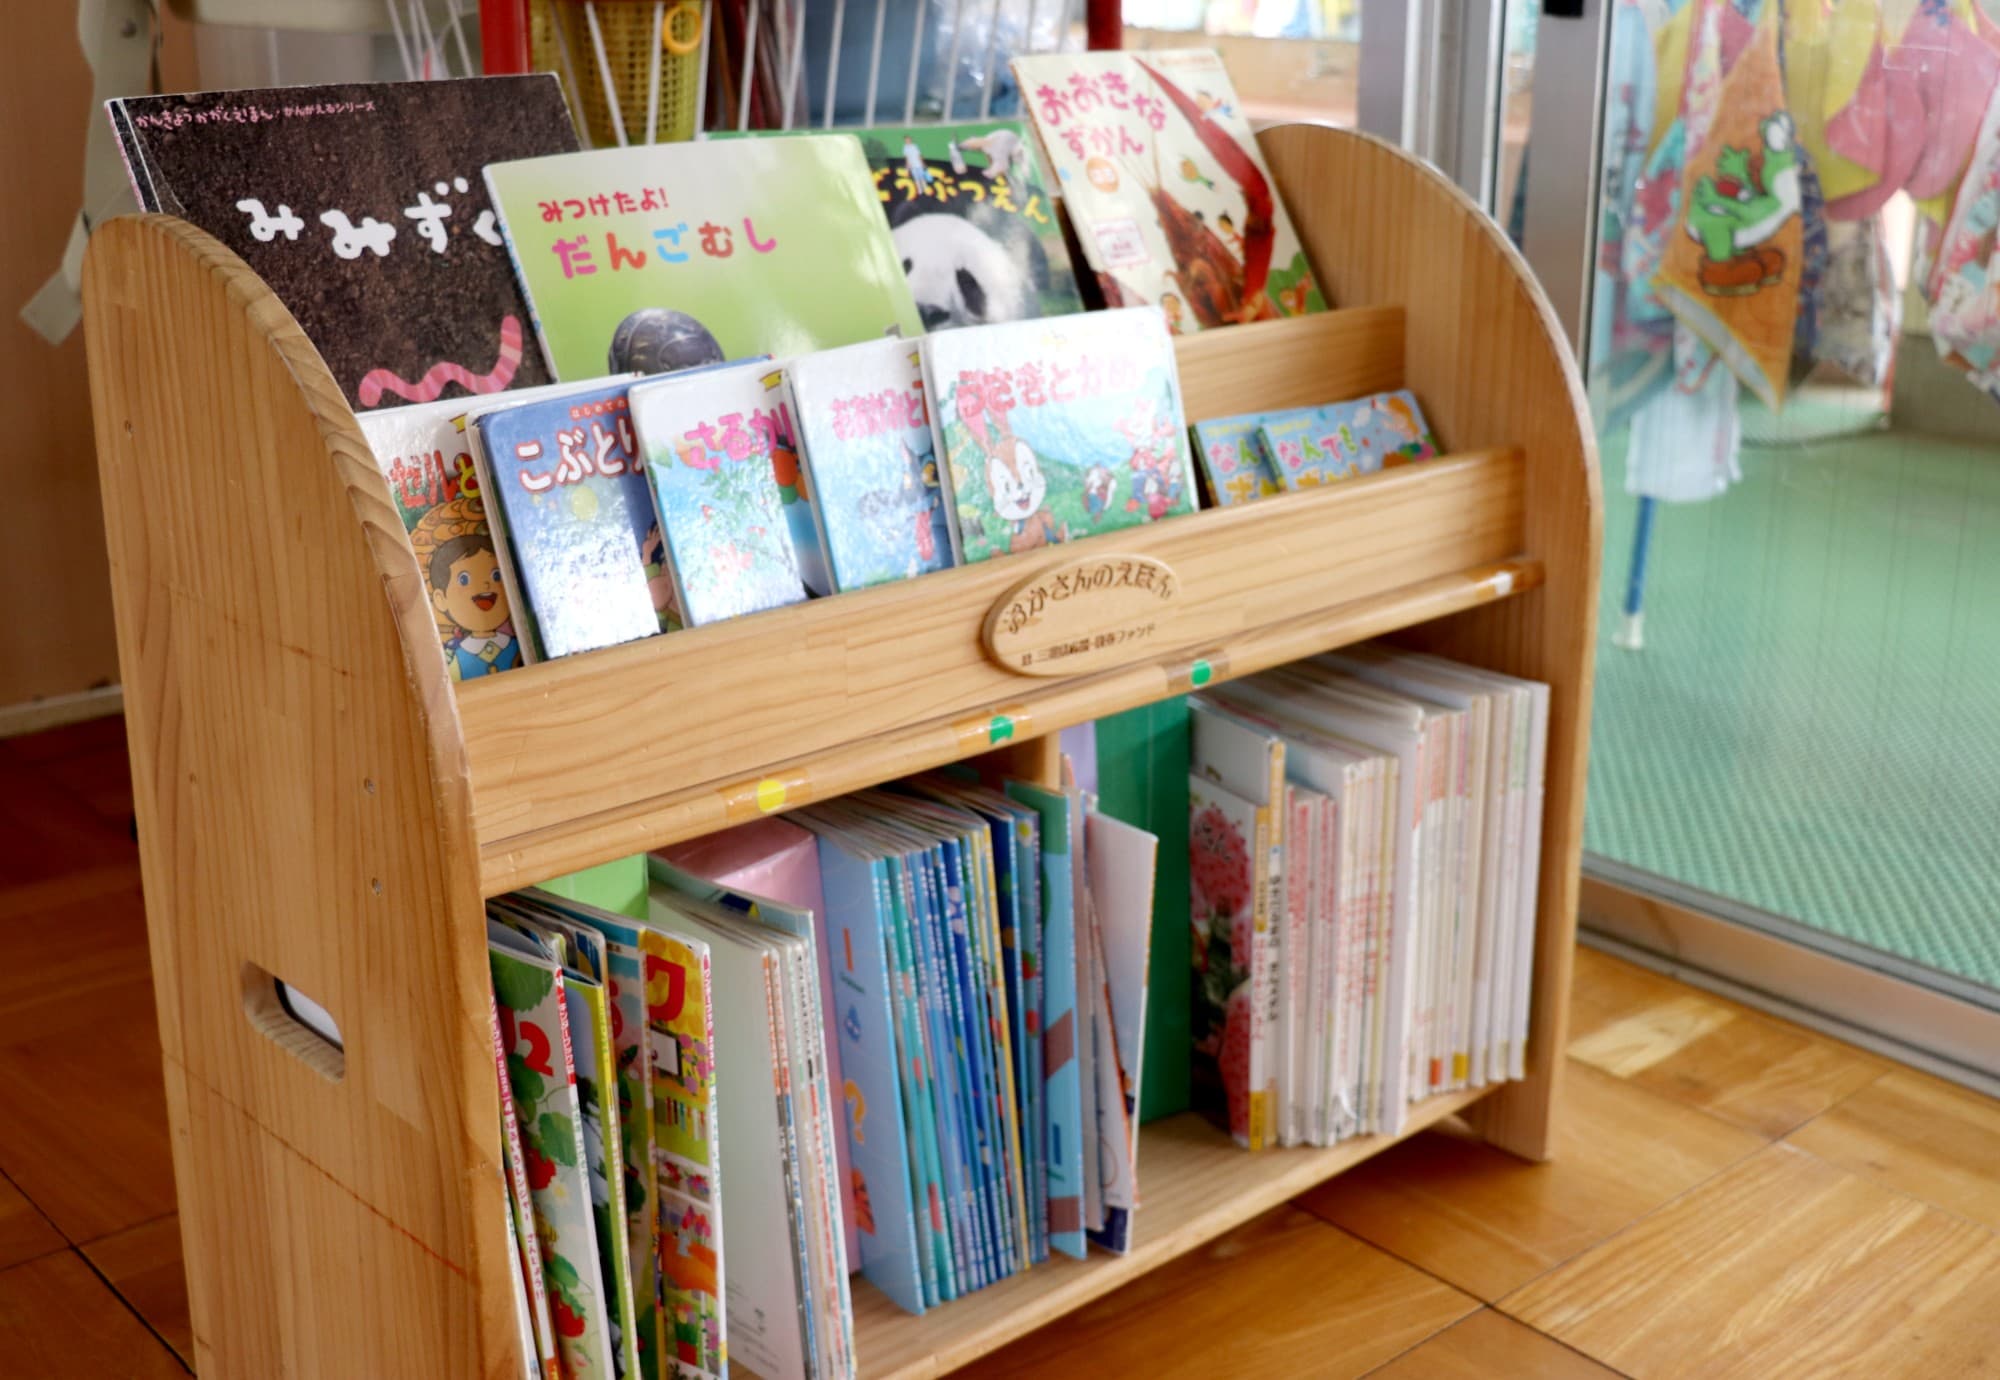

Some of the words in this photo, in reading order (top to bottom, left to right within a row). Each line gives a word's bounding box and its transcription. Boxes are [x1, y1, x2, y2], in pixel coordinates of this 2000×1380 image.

[1036, 71, 1166, 131] おおきな
[1060, 124, 1144, 161] ずかん
[551, 217, 777, 280] だんごむし
[957, 354, 1137, 418] うさぎとかめ
